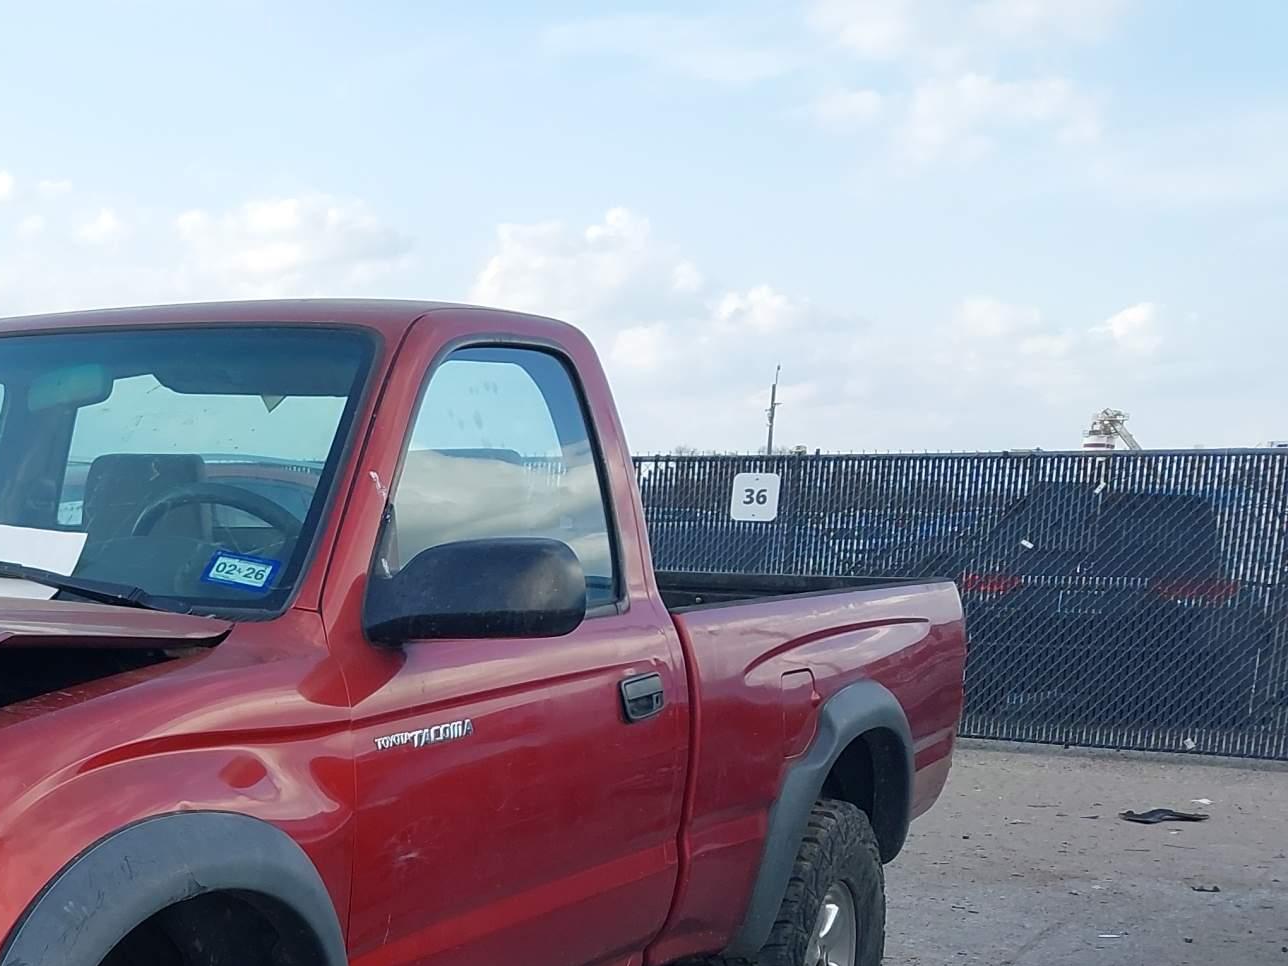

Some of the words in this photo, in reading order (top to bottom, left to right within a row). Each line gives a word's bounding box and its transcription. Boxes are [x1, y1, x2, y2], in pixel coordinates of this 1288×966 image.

[742, 488, 768, 505] 36
[374, 732, 411, 750] TOYOTA
[410, 719, 473, 748] TACOMA
